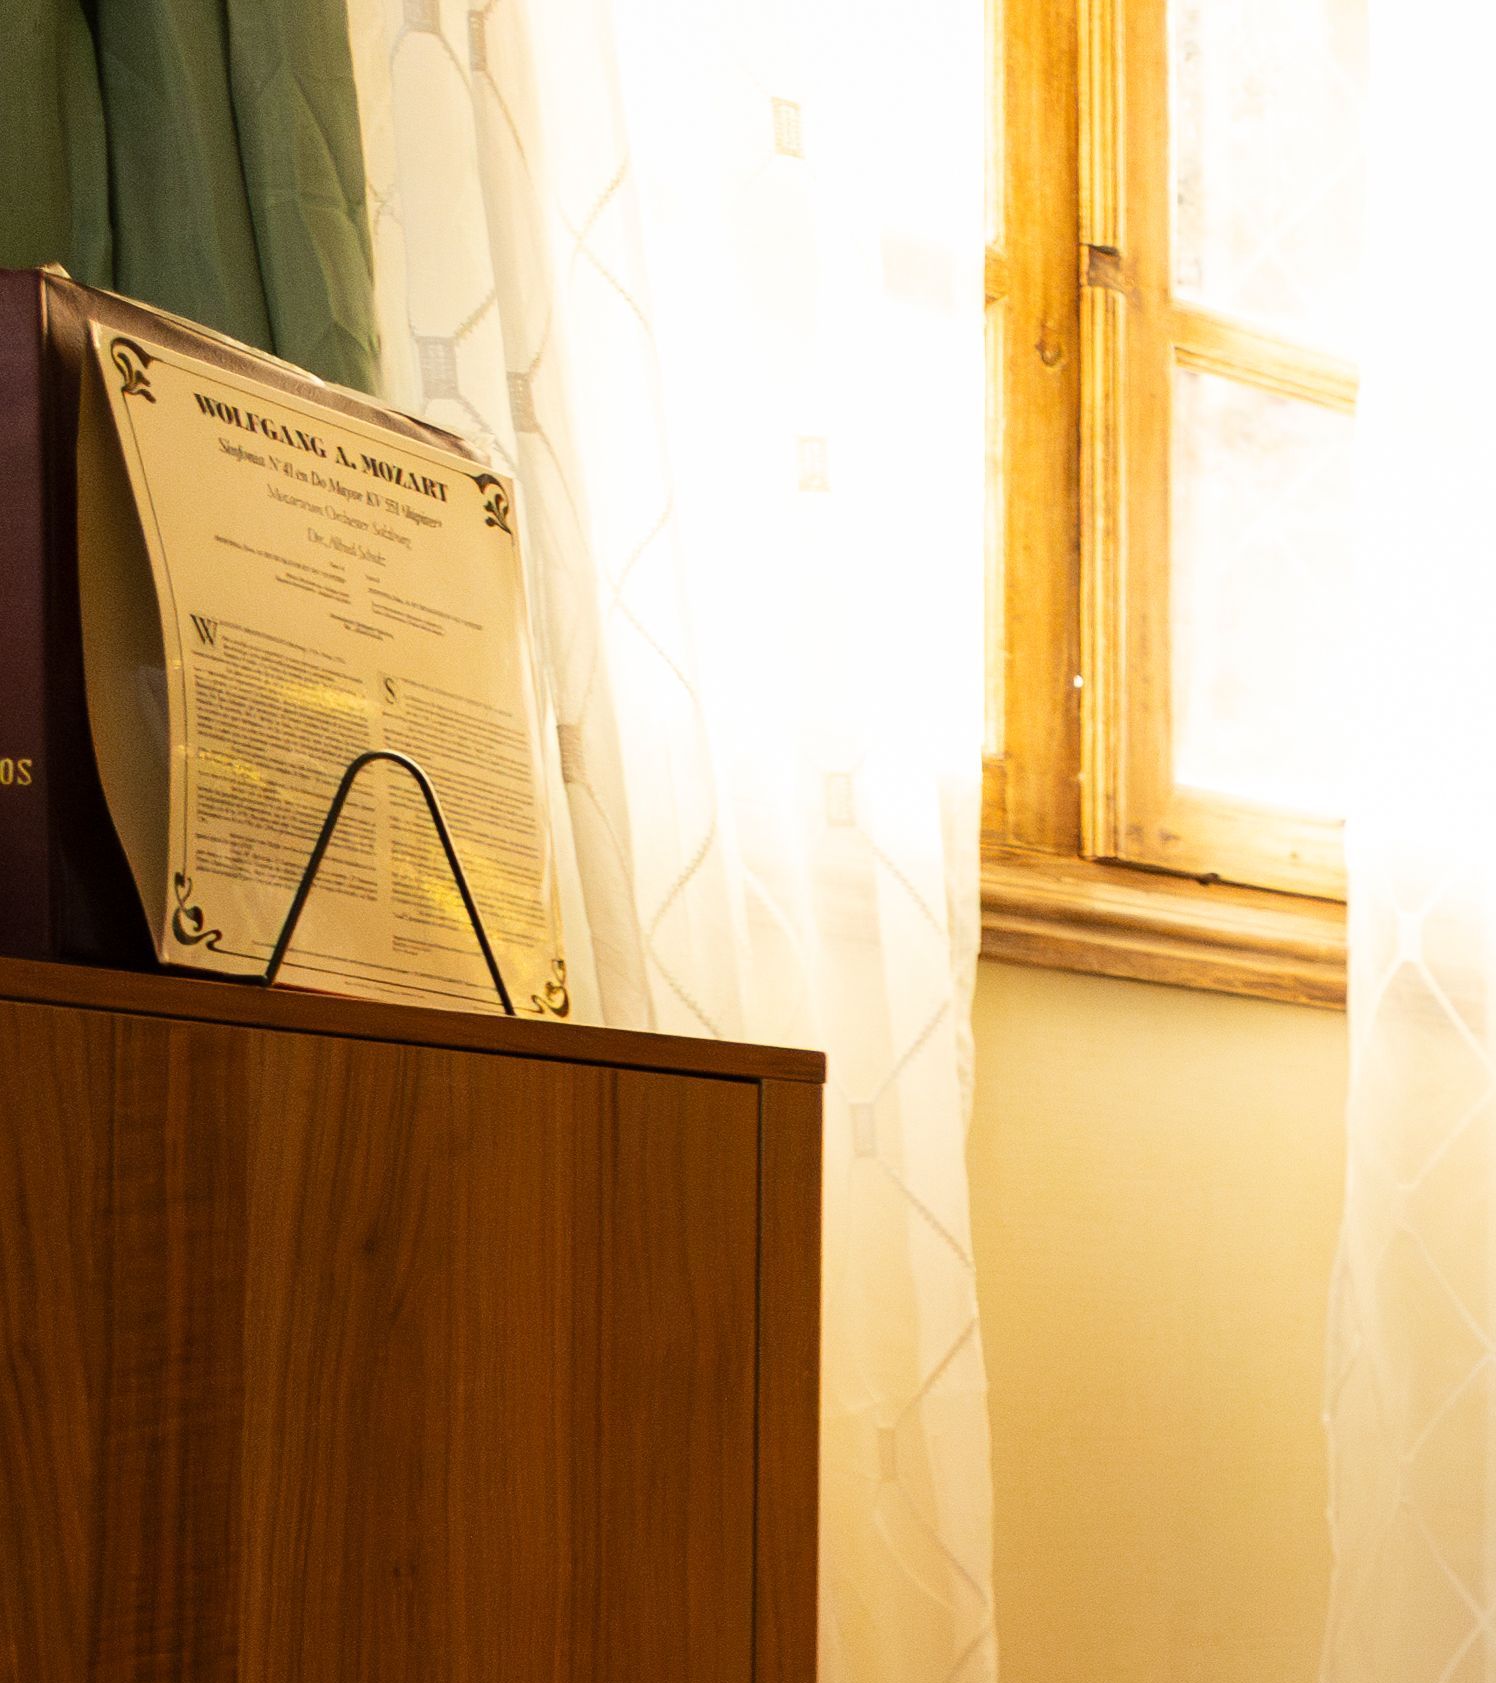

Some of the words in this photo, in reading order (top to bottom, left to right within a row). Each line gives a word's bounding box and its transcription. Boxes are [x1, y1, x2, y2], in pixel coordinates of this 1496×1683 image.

[193, 392, 327, 459] WOLFGANG
[335, 446, 357, 470] A.
[360, 453, 449, 503] MOZART
